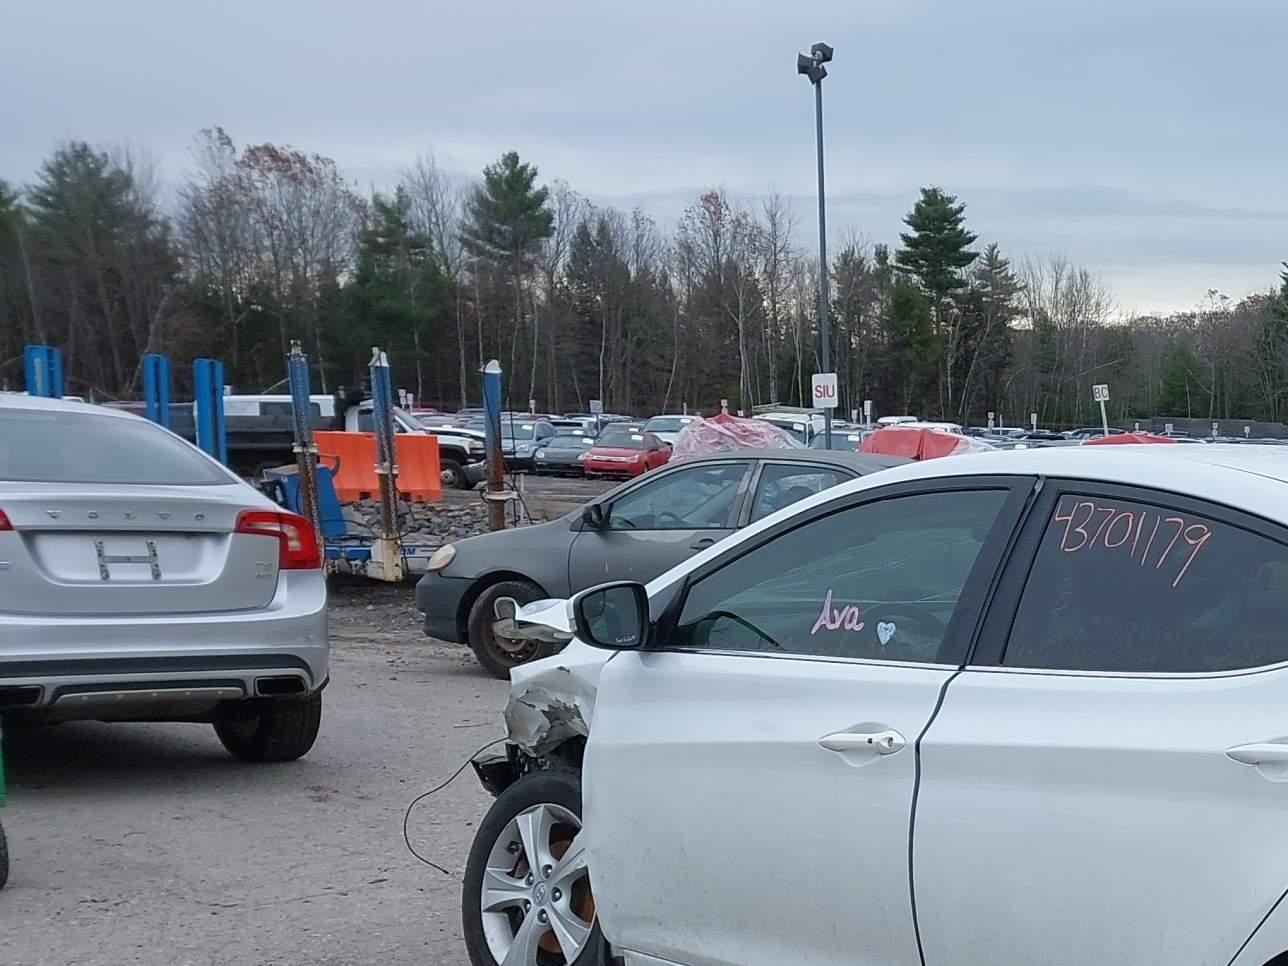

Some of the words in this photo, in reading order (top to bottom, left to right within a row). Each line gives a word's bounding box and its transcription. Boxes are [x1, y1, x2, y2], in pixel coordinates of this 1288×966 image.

[814, 384, 835, 399] SIU
[1095, 387, 1108, 399] BC
[45, 510, 206, 520] VOLVO
[1054, 500, 1212, 588] 43701179
[810, 588, 865, 636] Ava
